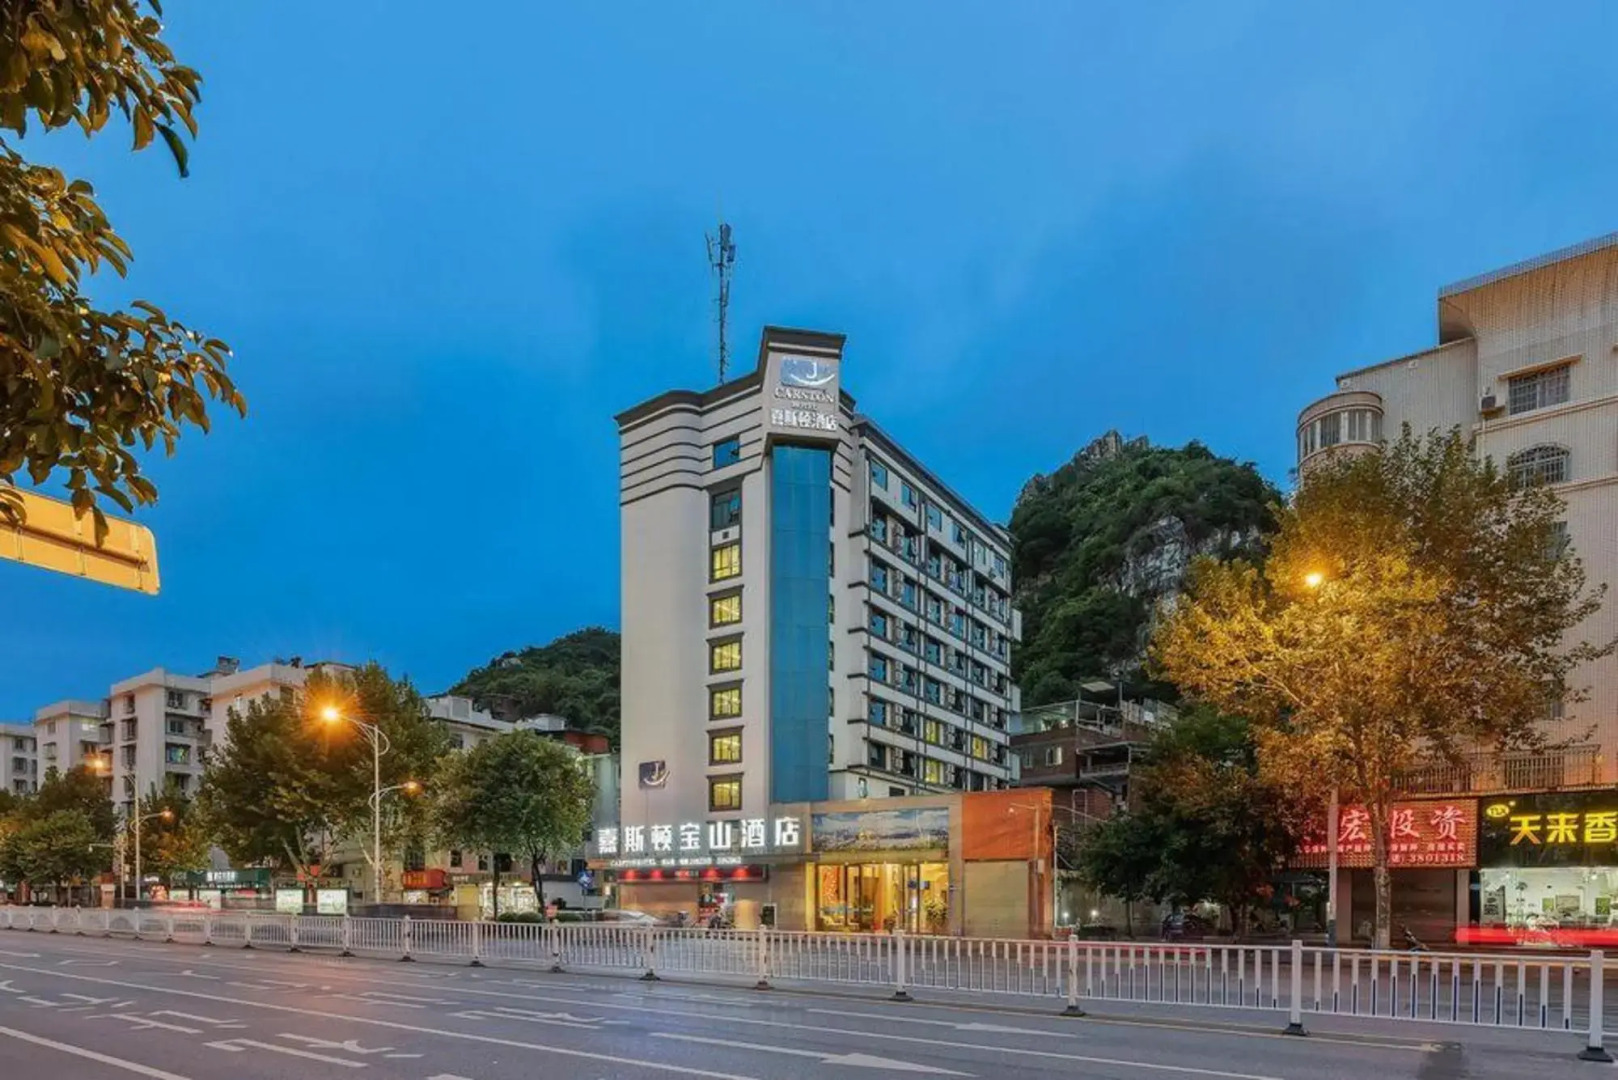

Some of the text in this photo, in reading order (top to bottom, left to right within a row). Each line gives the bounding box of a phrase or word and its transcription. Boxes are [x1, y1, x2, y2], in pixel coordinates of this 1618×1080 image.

[774, 387, 835, 403] CARSTON
[598, 816, 800, 854] 嘉斯顿宝山酒店
[1510, 811, 1618, 845] 天来香
